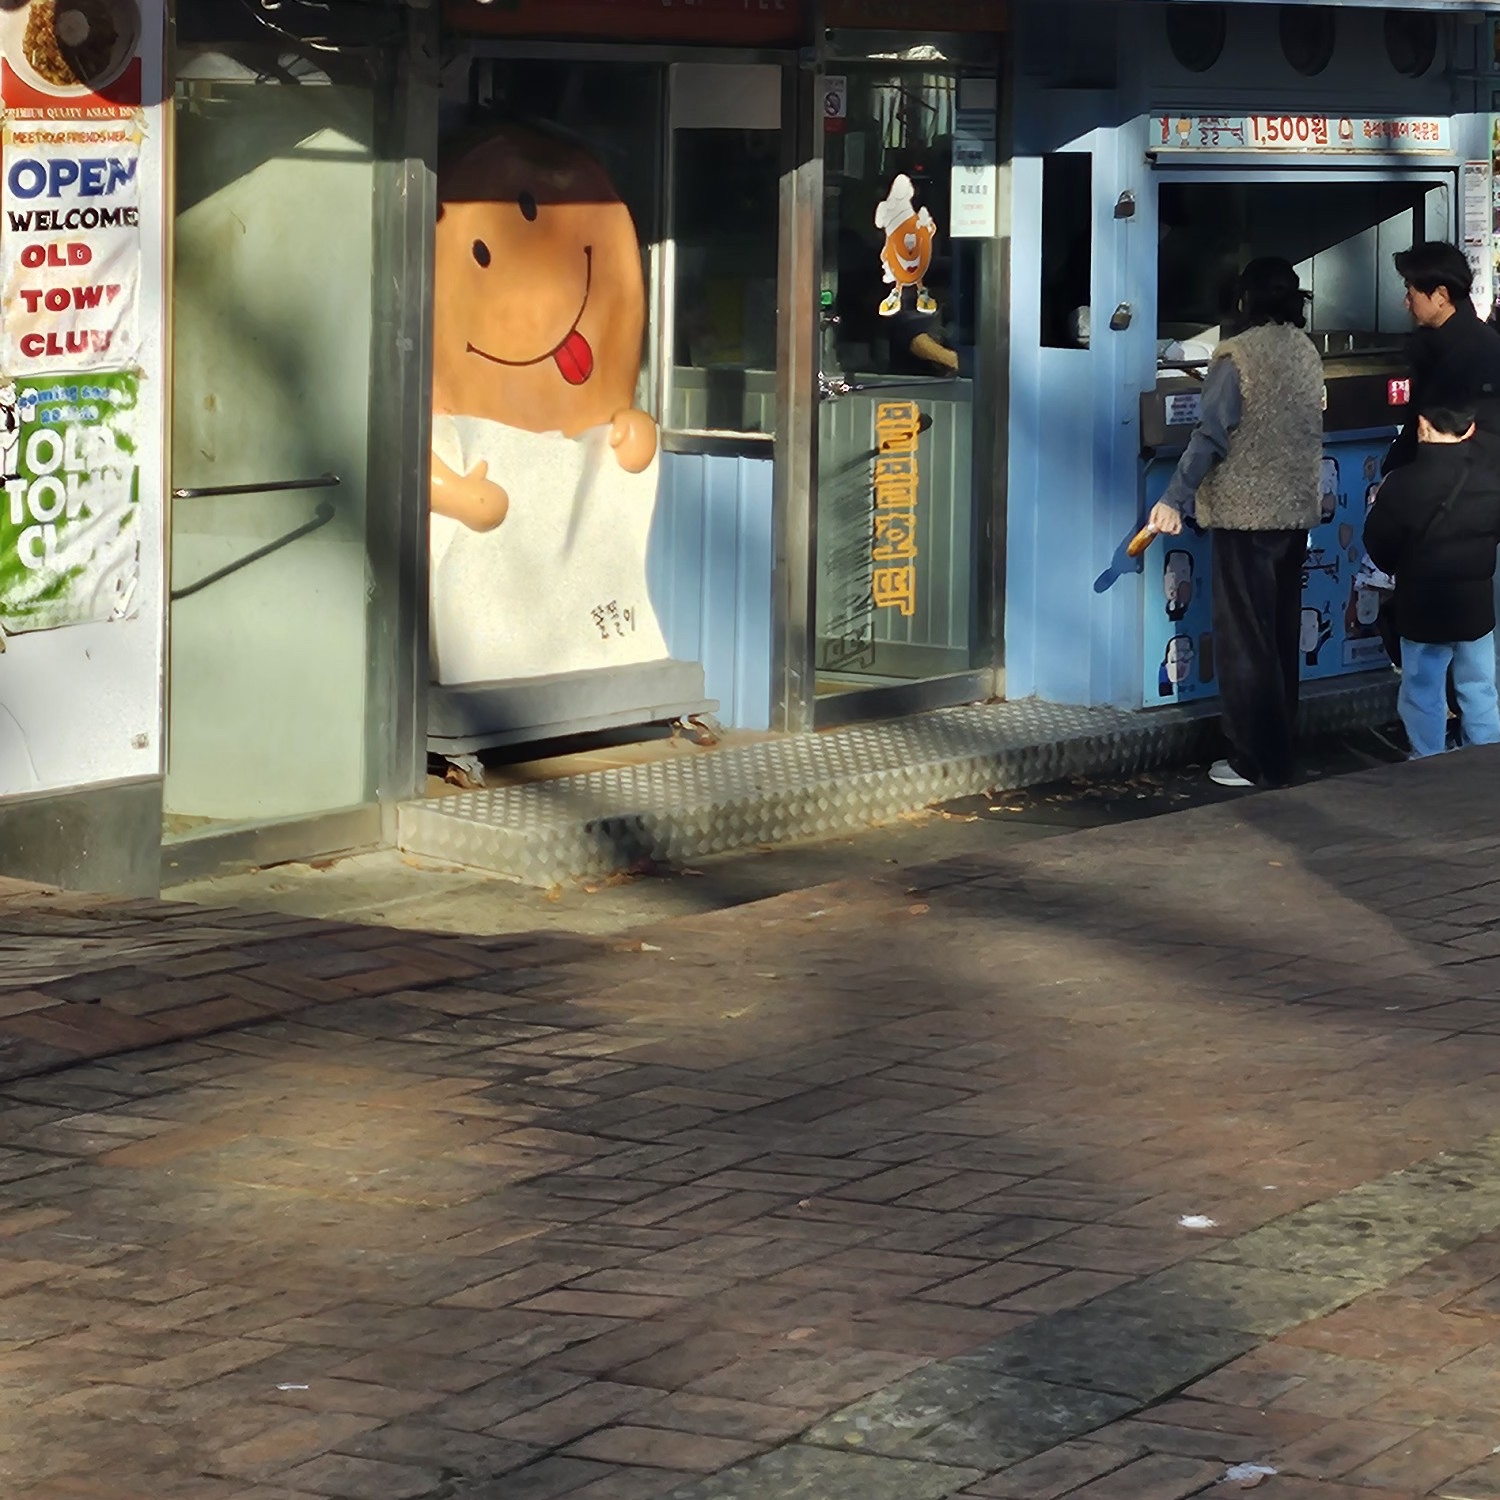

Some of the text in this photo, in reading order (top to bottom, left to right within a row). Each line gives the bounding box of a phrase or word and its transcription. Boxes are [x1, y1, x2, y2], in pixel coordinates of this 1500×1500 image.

[1250, 115, 1329, 145] 1,500원
[8, 157, 138, 199] OPEN
[7, 205, 139, 232] WELCOME
[21, 242, 93, 268] OLD
